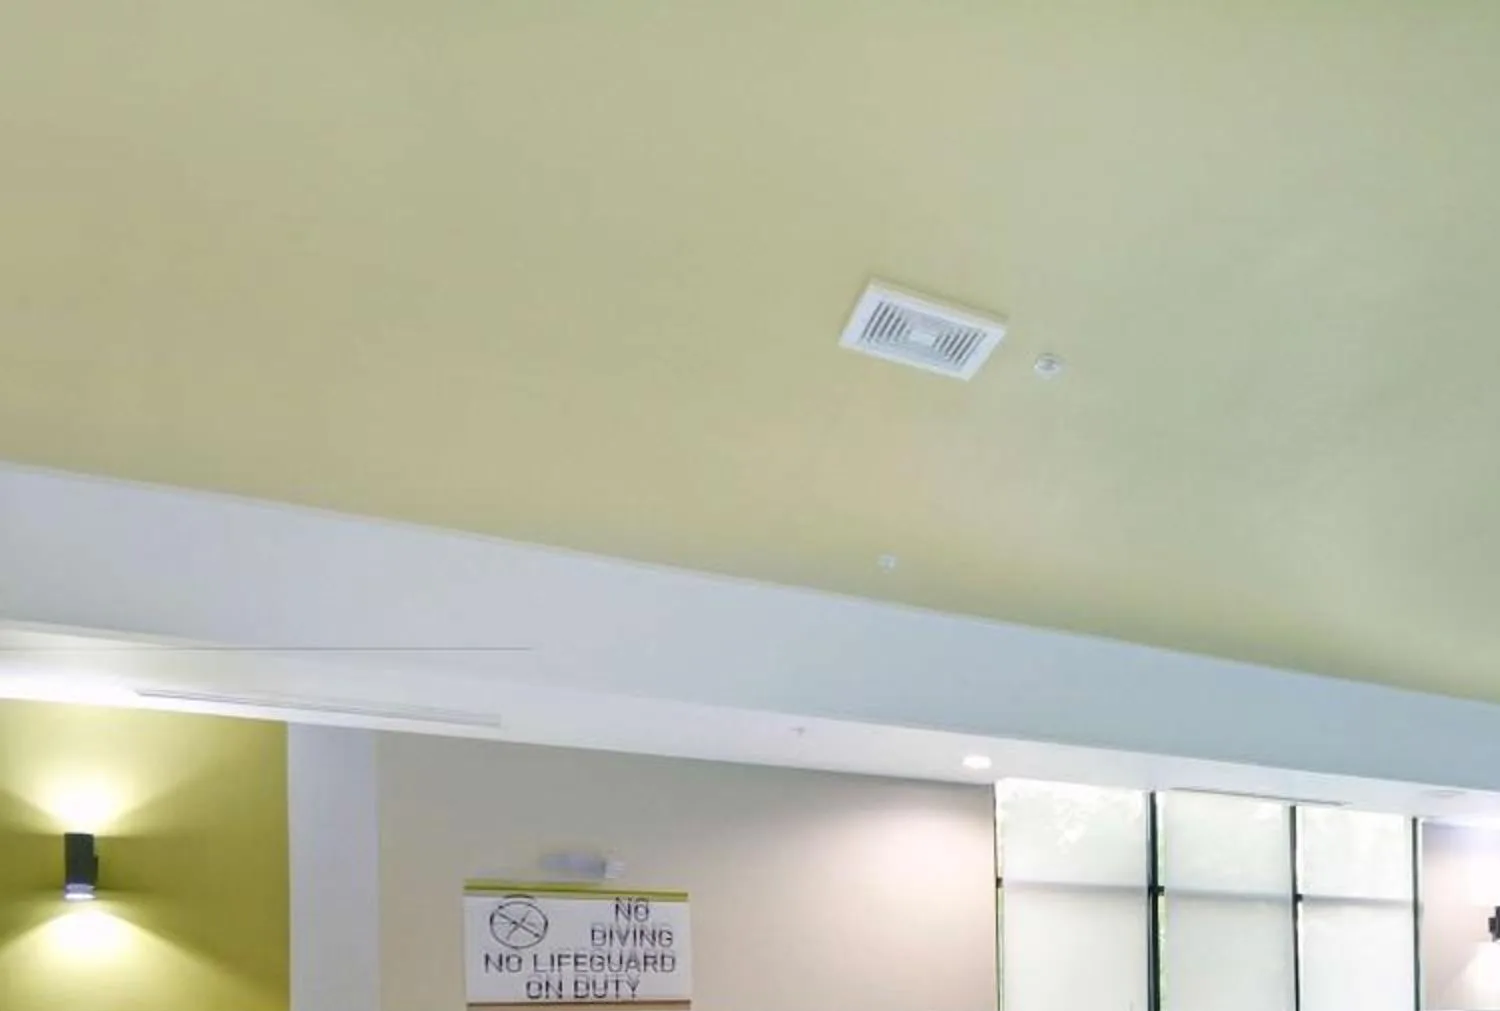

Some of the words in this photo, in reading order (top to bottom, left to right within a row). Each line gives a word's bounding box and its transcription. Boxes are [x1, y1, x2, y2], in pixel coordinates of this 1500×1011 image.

[614, 897, 650, 921] NO
[591, 926, 674, 947] DIVING
[483, 953, 523, 973] NO
[532, 953, 677, 973] LIFEGUARD
[526, 979, 563, 999] ON
[573, 978, 640, 999] DUTY
